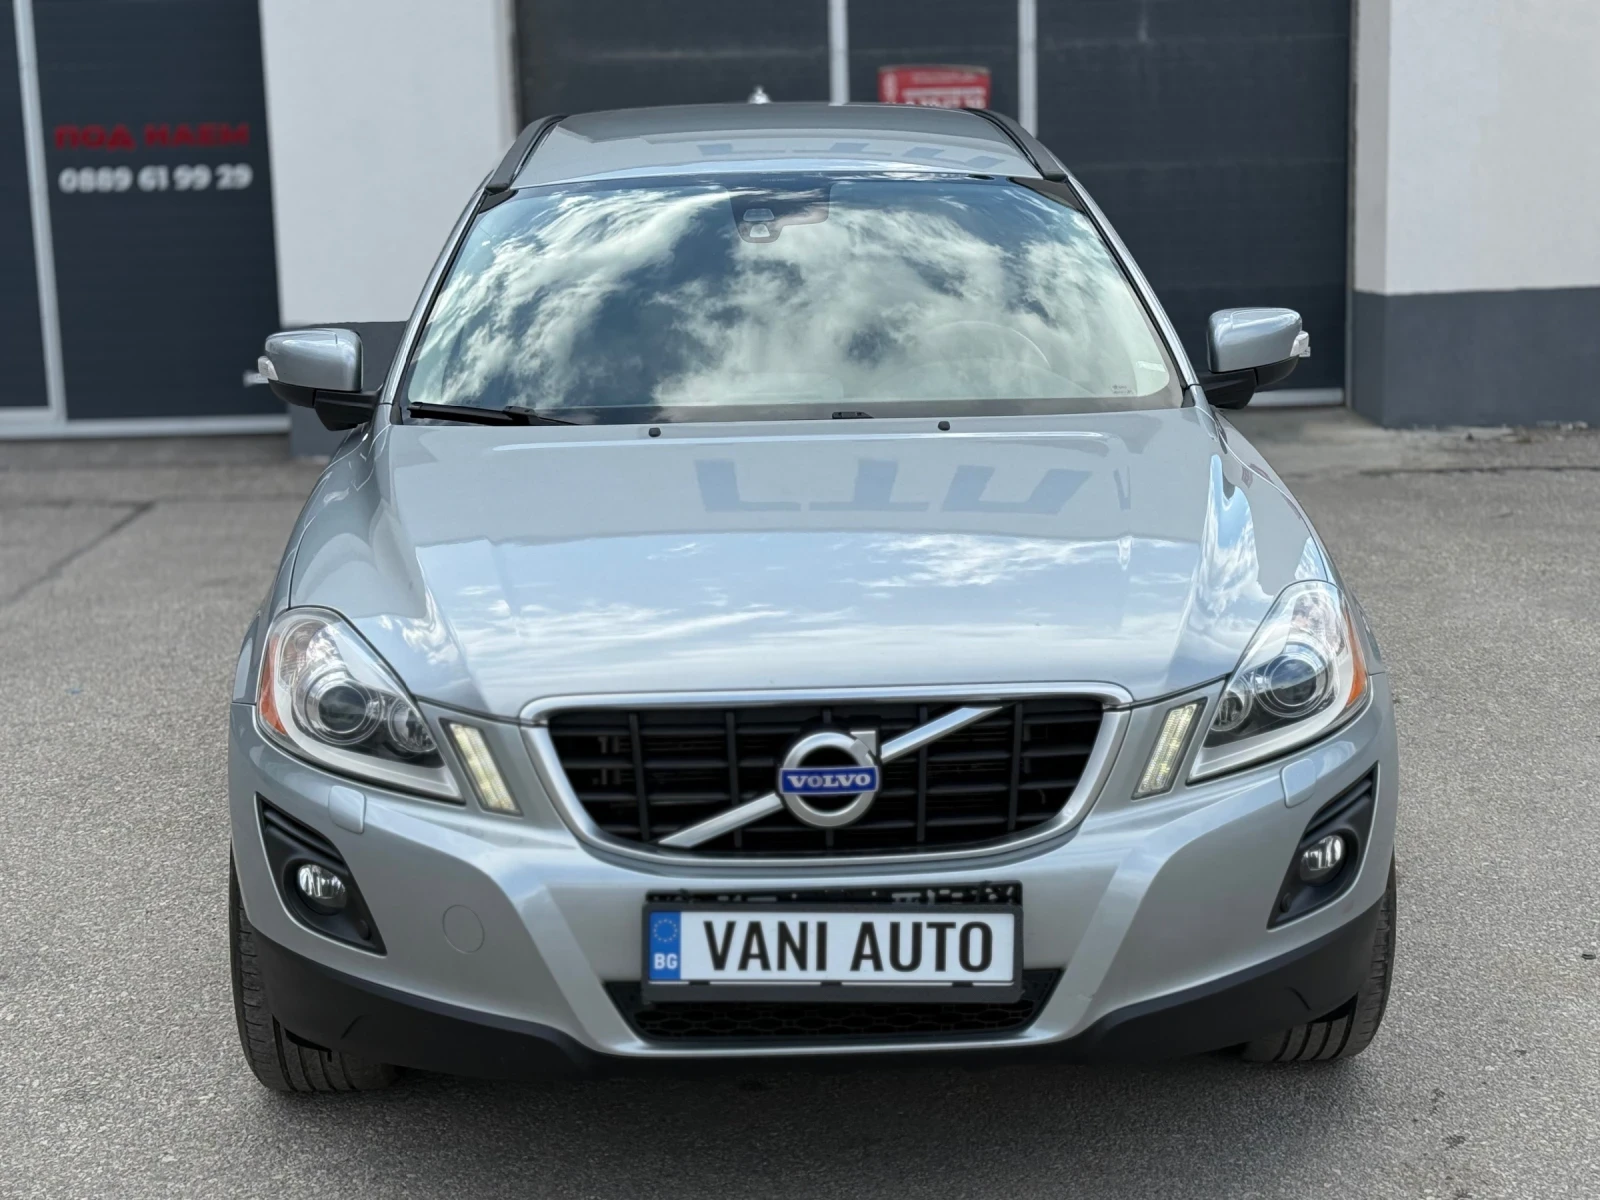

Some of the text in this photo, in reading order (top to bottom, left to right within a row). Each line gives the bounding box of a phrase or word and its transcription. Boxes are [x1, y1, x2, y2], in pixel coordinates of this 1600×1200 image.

[54, 122, 250, 151] ПОД НАЕМ
[58, 163, 254, 193] 0889 61 99 29
[787, 774, 871, 788] VOLVO
[704, 921, 993, 972] VANI AUTO
[654, 954, 678, 969] BG
